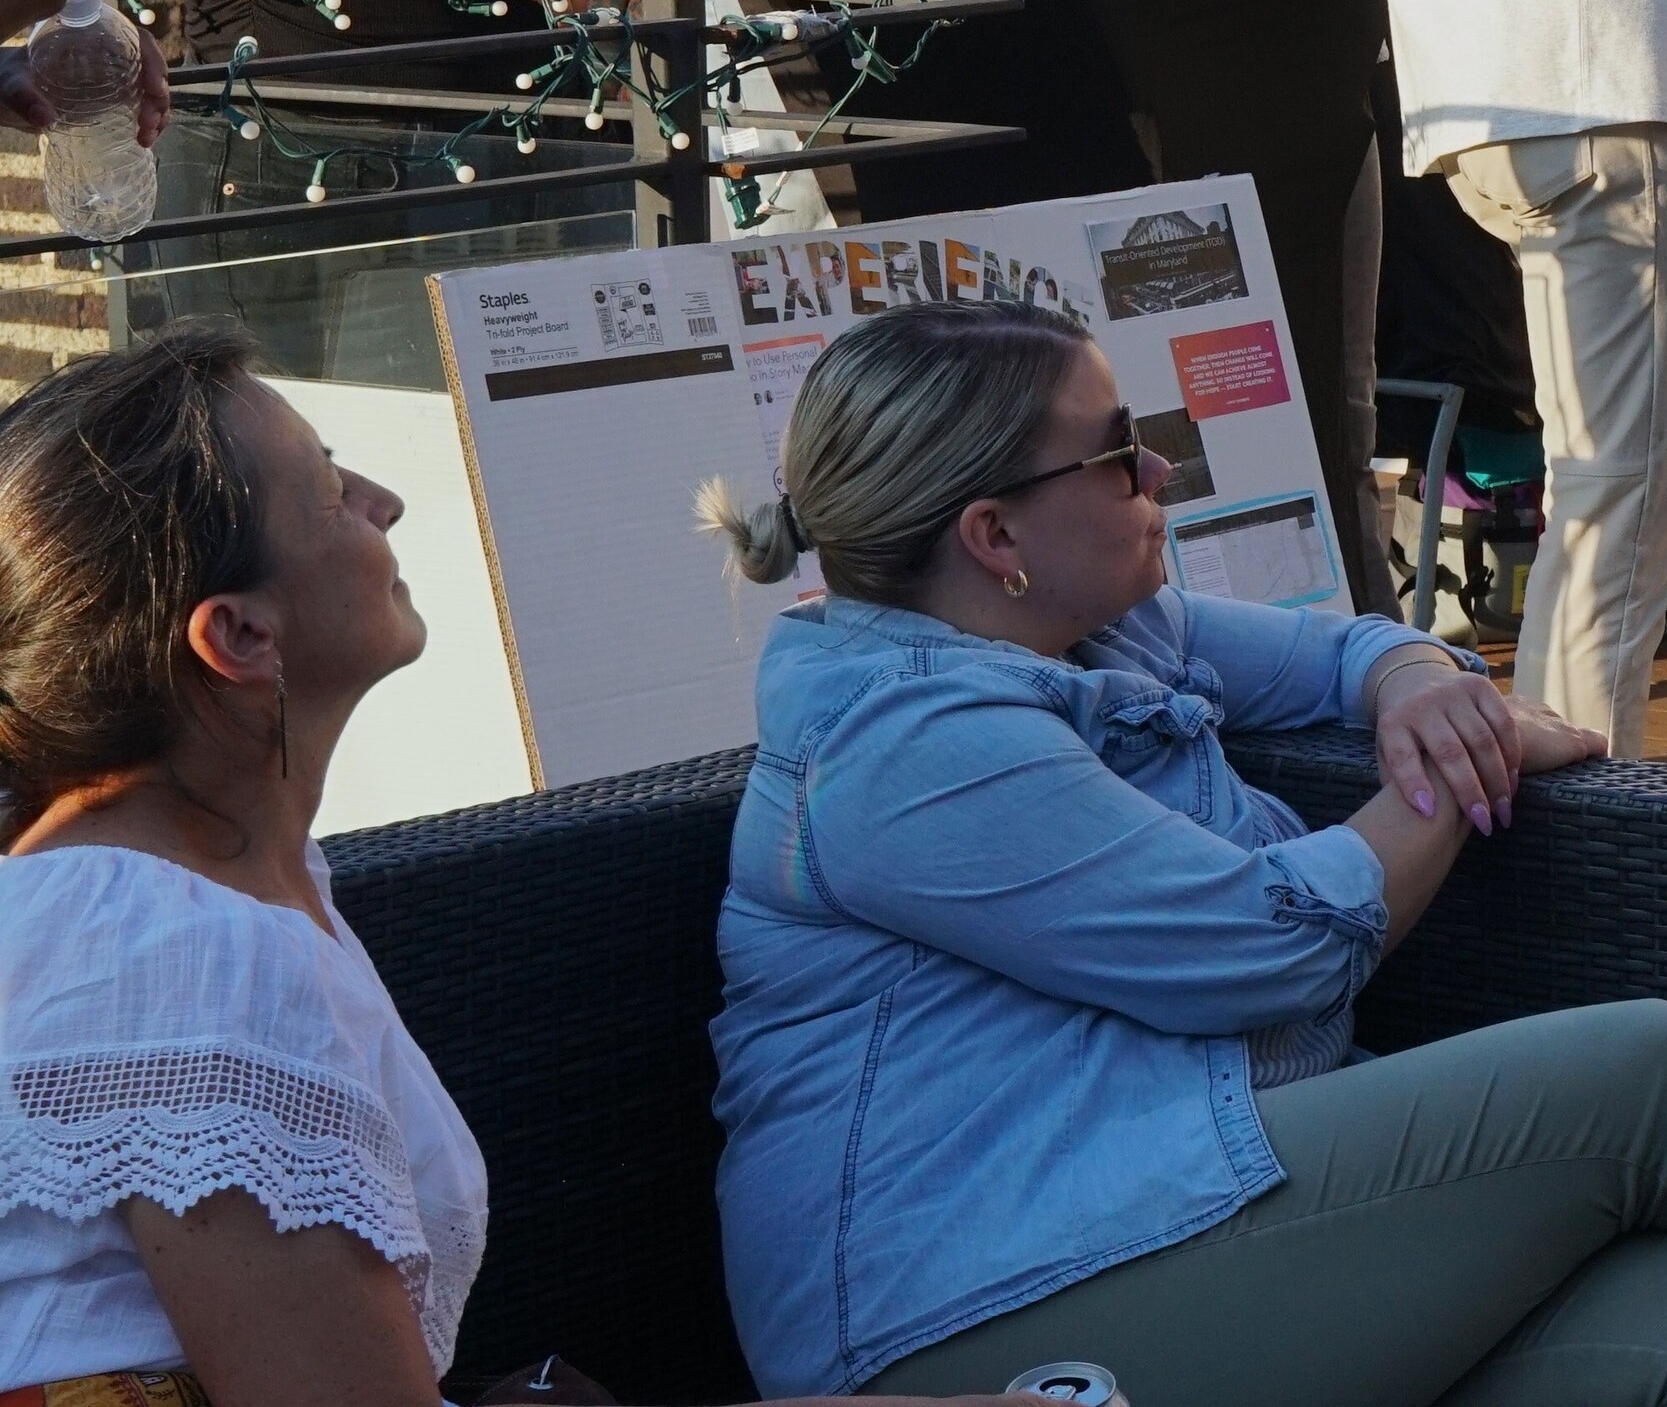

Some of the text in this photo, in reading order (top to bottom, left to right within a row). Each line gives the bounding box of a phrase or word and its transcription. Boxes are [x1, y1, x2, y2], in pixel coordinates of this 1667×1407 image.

[1105, 247, 1160, 264] Transit-Oriented
[1160, 241, 1205, 257] Development
[1149, 256, 1189, 270] in Maryland
[479, 291, 529, 311] Staples
[484, 310, 539, 326] Heavyweight
[486, 321, 570, 340] Tri-fold Project Board
[516, 345, 526, 355] Ply
[763, 354, 782, 365] Use
[782, 345, 818, 362] Personal
[1229, 348, 1248, 357] PEOPLE
[769, 367, 791, 380] Story
